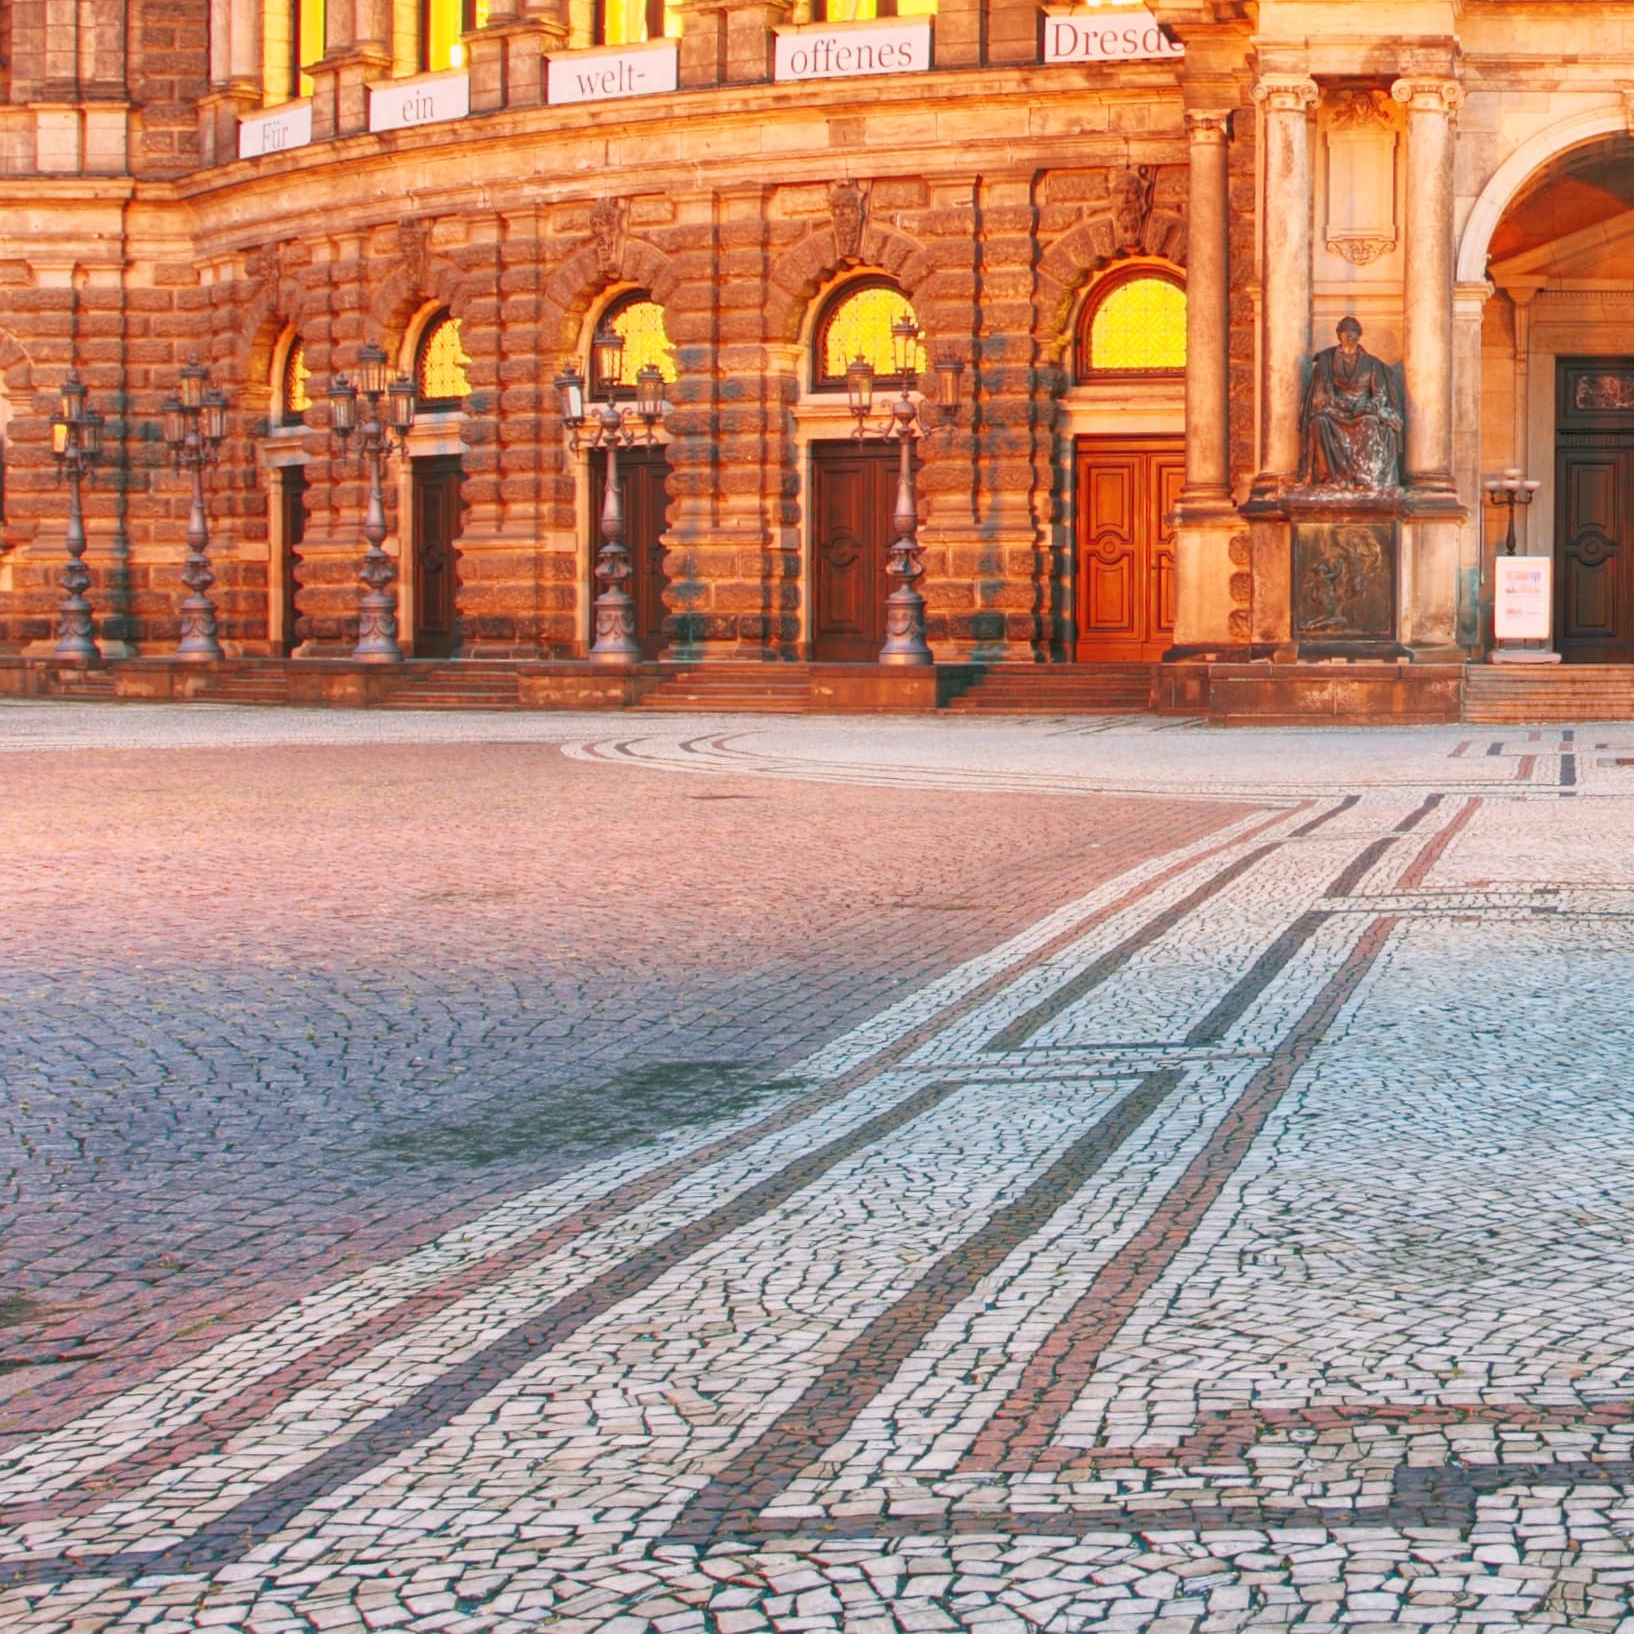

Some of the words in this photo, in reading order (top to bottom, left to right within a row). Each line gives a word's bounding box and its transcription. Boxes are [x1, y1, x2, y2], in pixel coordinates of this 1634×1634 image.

[790, 38, 912, 74] offenes
[577, 60, 645, 96] welt-
[401, 90, 434, 122] ein
[262, 120, 289, 152] Für
